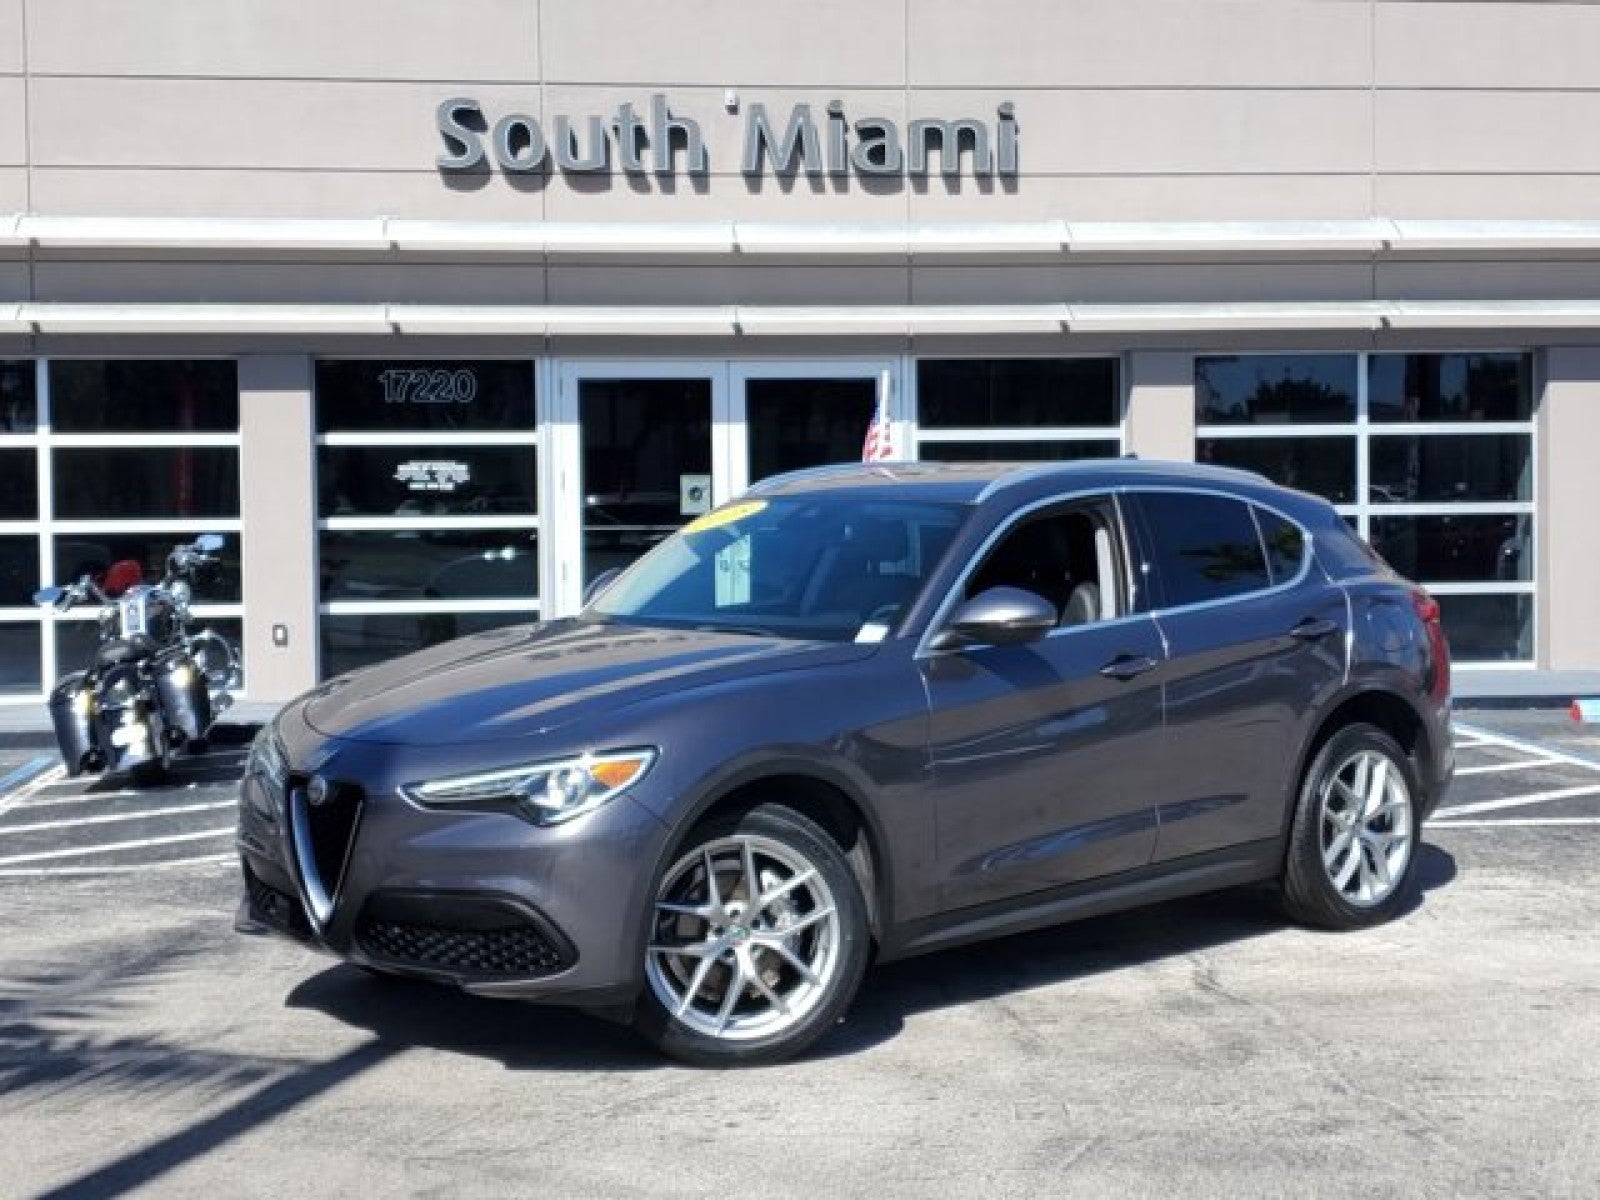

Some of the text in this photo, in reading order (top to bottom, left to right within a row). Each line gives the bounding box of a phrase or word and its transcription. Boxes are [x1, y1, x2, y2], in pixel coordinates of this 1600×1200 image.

[436, 94, 1018, 172] South Miami
[378, 369, 476, 403] 17220
